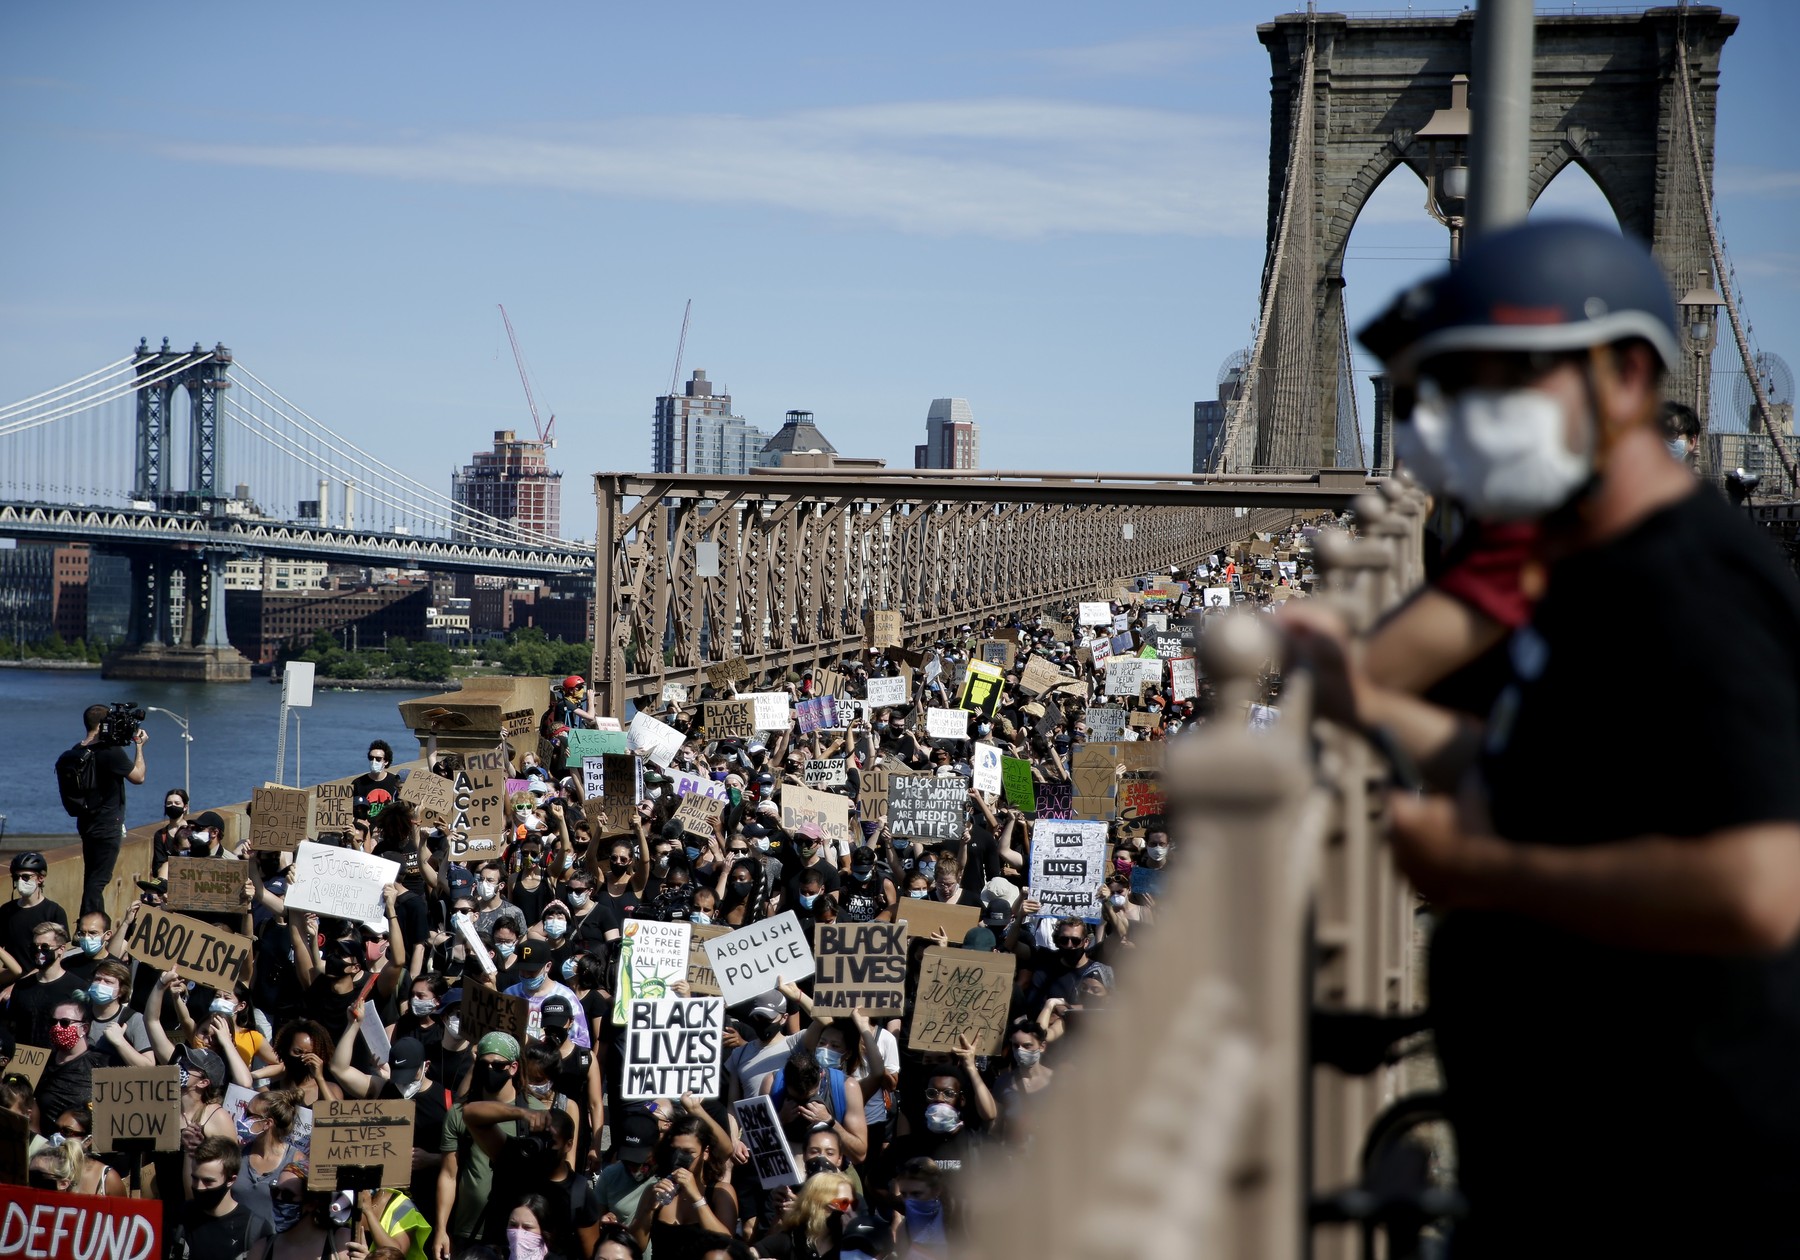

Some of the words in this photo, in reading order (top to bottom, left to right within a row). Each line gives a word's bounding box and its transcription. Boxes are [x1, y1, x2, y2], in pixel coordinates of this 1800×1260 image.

[1157, 637, 1181, 645] BLACK
[1158, 644, 1181, 652] LIVES
[1156, 650, 1182, 658] MATTER
[1173, 661, 1195, 673] BLACK
[814, 668, 846, 700] BLM
[1174, 676, 1195, 685] LIVES
[706, 703, 749, 717] BLACK
[509, 716, 532, 728] LIVES
[712, 714, 748, 726] LIVES
[507, 727, 530, 738] MATTER
[569, 730, 616, 744] ARREST
[707, 723, 754, 739] MATTER
[467, 752, 503, 770] FUCK
[607, 757, 627, 769] NO
[805, 760, 844, 770] ABOLISH
[413, 771, 442, 787] BLACK
[805, 772, 833, 781] NYPD
[896, 777, 933, 790] BLACK
[937, 778, 966, 788] LIVES
[316, 785, 354, 799] DEFUND
[419, 783, 445, 796] LIVES
[610, 782, 627, 793] NO
[904, 787, 923, 799] ARE
[927, 788, 969, 801] WORTHY
[978, 782, 996, 792] NYPD
[255, 789, 307, 813] POWER
[323, 798, 346, 812] THE
[404, 788, 448, 811] MATTER!
[604, 794, 635, 806] PEACE
[686, 792, 707, 809] WHY
[707, 800, 719, 813] IS
[894, 799, 912, 809] ARE
[915, 800, 963, 811] BEAUTIFUL
[258, 813, 279, 827] TO
[281, 813, 307, 830] THE
[315, 811, 353, 827] POLICE
[898, 810, 913, 820] ARE
[916, 810, 957, 823] NEEDED
[688, 820, 713, 836] HARD
[891, 819, 960, 839] MATTER
[252, 829, 304, 846] PEOPLE
[1055, 836, 1081, 844] BLACK
[312, 850, 385, 882] JUSTICE
[1048, 863, 1083, 873] LIVES
[180, 868, 205, 881] SAY
[211, 870, 240, 883] THEIR
[194, 882, 232, 895] NAMES
[308, 877, 363, 904] ROBERT
[1041, 892, 1090, 903] MATTER
[330, 897, 385, 919] FULLER
[848, 904, 866, 914] WAR
[641, 926, 658, 935] NO
[661, 927, 684, 937] ONE
[130, 913, 248, 981] ABOLISH
[639, 936, 650, 945] IS
[655, 937, 681, 948] FREE
[716, 920, 793, 960] ABOLISH
[820, 925, 906, 955] BLACK
[637, 946, 655, 954] UNTIL
[635, 956, 656, 966] ALL
[660, 957, 684, 968] FREE
[725, 941, 804, 986] POLICE
[816, 955, 906, 983] LIVES
[949, 966, 983, 985] NO
[472, 986, 516, 1015] BLACK
[813, 990, 904, 1009] MATTER
[923, 983, 1000, 1010] JUSTICE
[468, 1000, 517, 1032] LIVES
[632, 1000, 719, 1030] BLACK
[943, 1011, 969, 1024] NO
[629, 1030, 717, 1064] LIVES
[627, 1065, 716, 1095] MATTER
[95, 1080, 179, 1104] JUSTICE
[329, 1100, 383, 1116] BLACK
[110, 1113, 167, 1136] NOW
[738, 1102, 776, 1131] BLACK
[330, 1126, 387, 1143] LIVES
[626, 1136, 640, 1144] Daddy
[747, 1126, 782, 1155] LIVES
[327, 1141, 398, 1159] MATTER
[757, 1149, 793, 1179] MATTER
[1, 1200, 155, 1260] DEFUND
